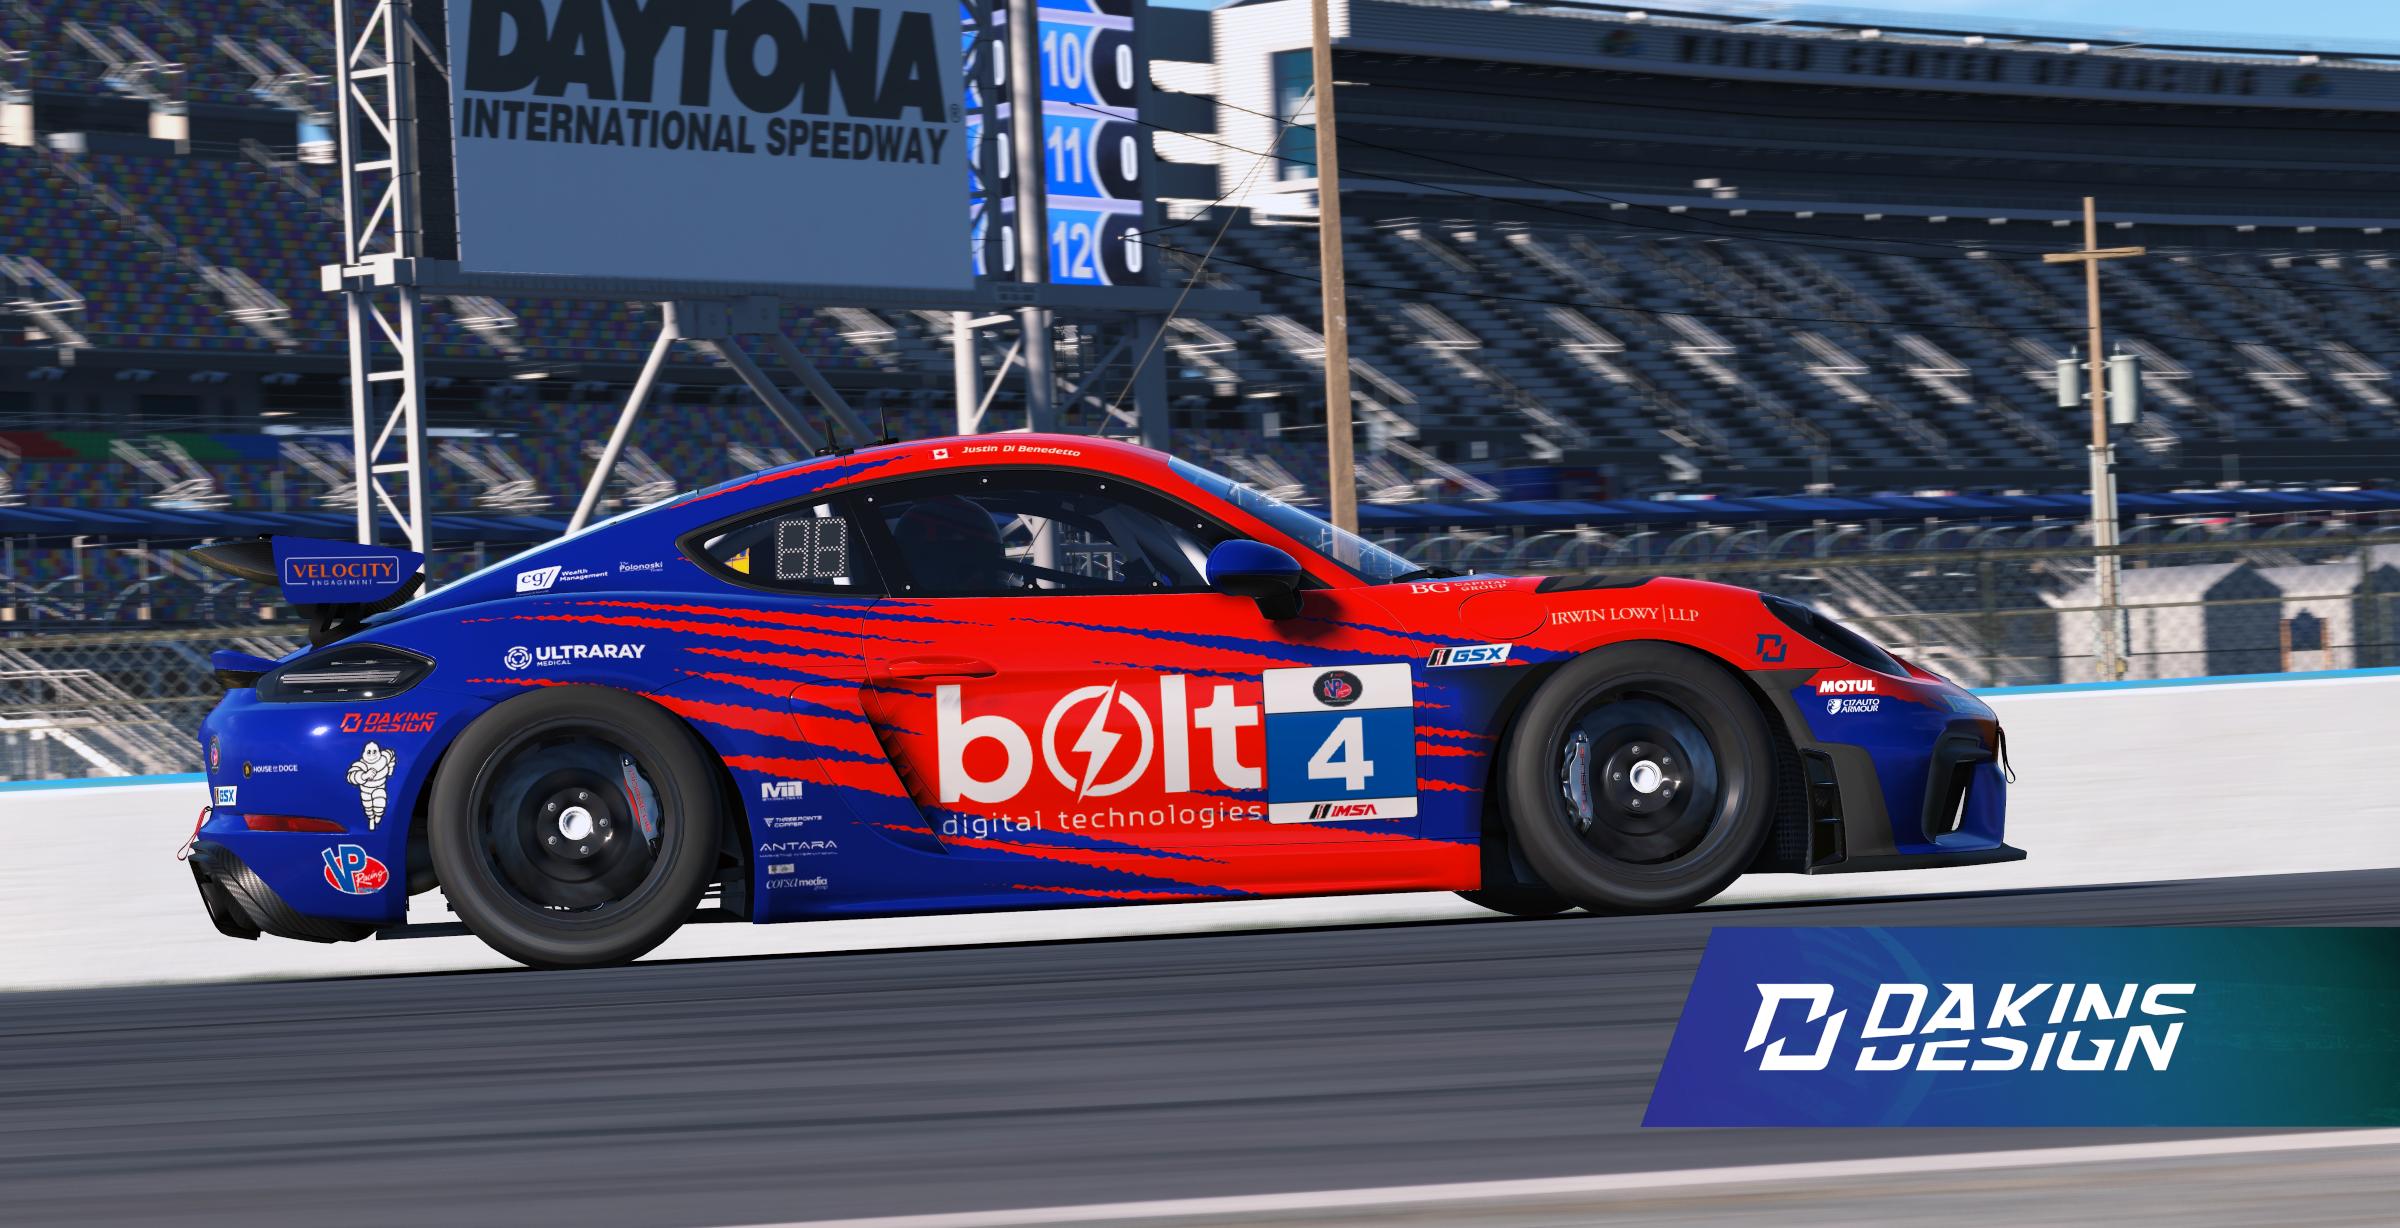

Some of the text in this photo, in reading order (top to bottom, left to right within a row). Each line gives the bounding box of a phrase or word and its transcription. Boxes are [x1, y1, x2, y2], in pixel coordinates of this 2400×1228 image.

[465, 0, 948, 124] DAYTONA
[1043, 30, 1082, 89] 10
[461, 98, 948, 165] INTERNATIONAL SPEEDWAY
[1048, 126, 1083, 183] 11
[1052, 220, 1094, 279] 12
[962, 445, 998, 454] Justin
[1018, 445, 1081, 457] Benedetto
[293, 563, 394, 579] VELOCITY
[561, 568, 588, 577] Wealth
[1409, 583, 1451, 594] BG
[1460, 583, 1507, 592] GROUP
[1551, 609, 1605, 625] IRWIN
[1610, 607, 1659, 621] LOWY
[536, 644, 646, 660] ULTRARAY
[1452, 646, 1505, 663] GSX
[1819, 680, 1876, 693] MOTUL
[1840, 705, 1879, 713] ARMOUR
[935, 674, 1262, 804] bolt
[1307, 716, 1374, 791] 4
[219, 789, 235, 803] GSX
[1331, 804, 1377, 817] IMSA
[942, 803, 1261, 839] digital technologies
[760, 840, 838, 852] ANTARA
[321, 844, 367, 893] VP
